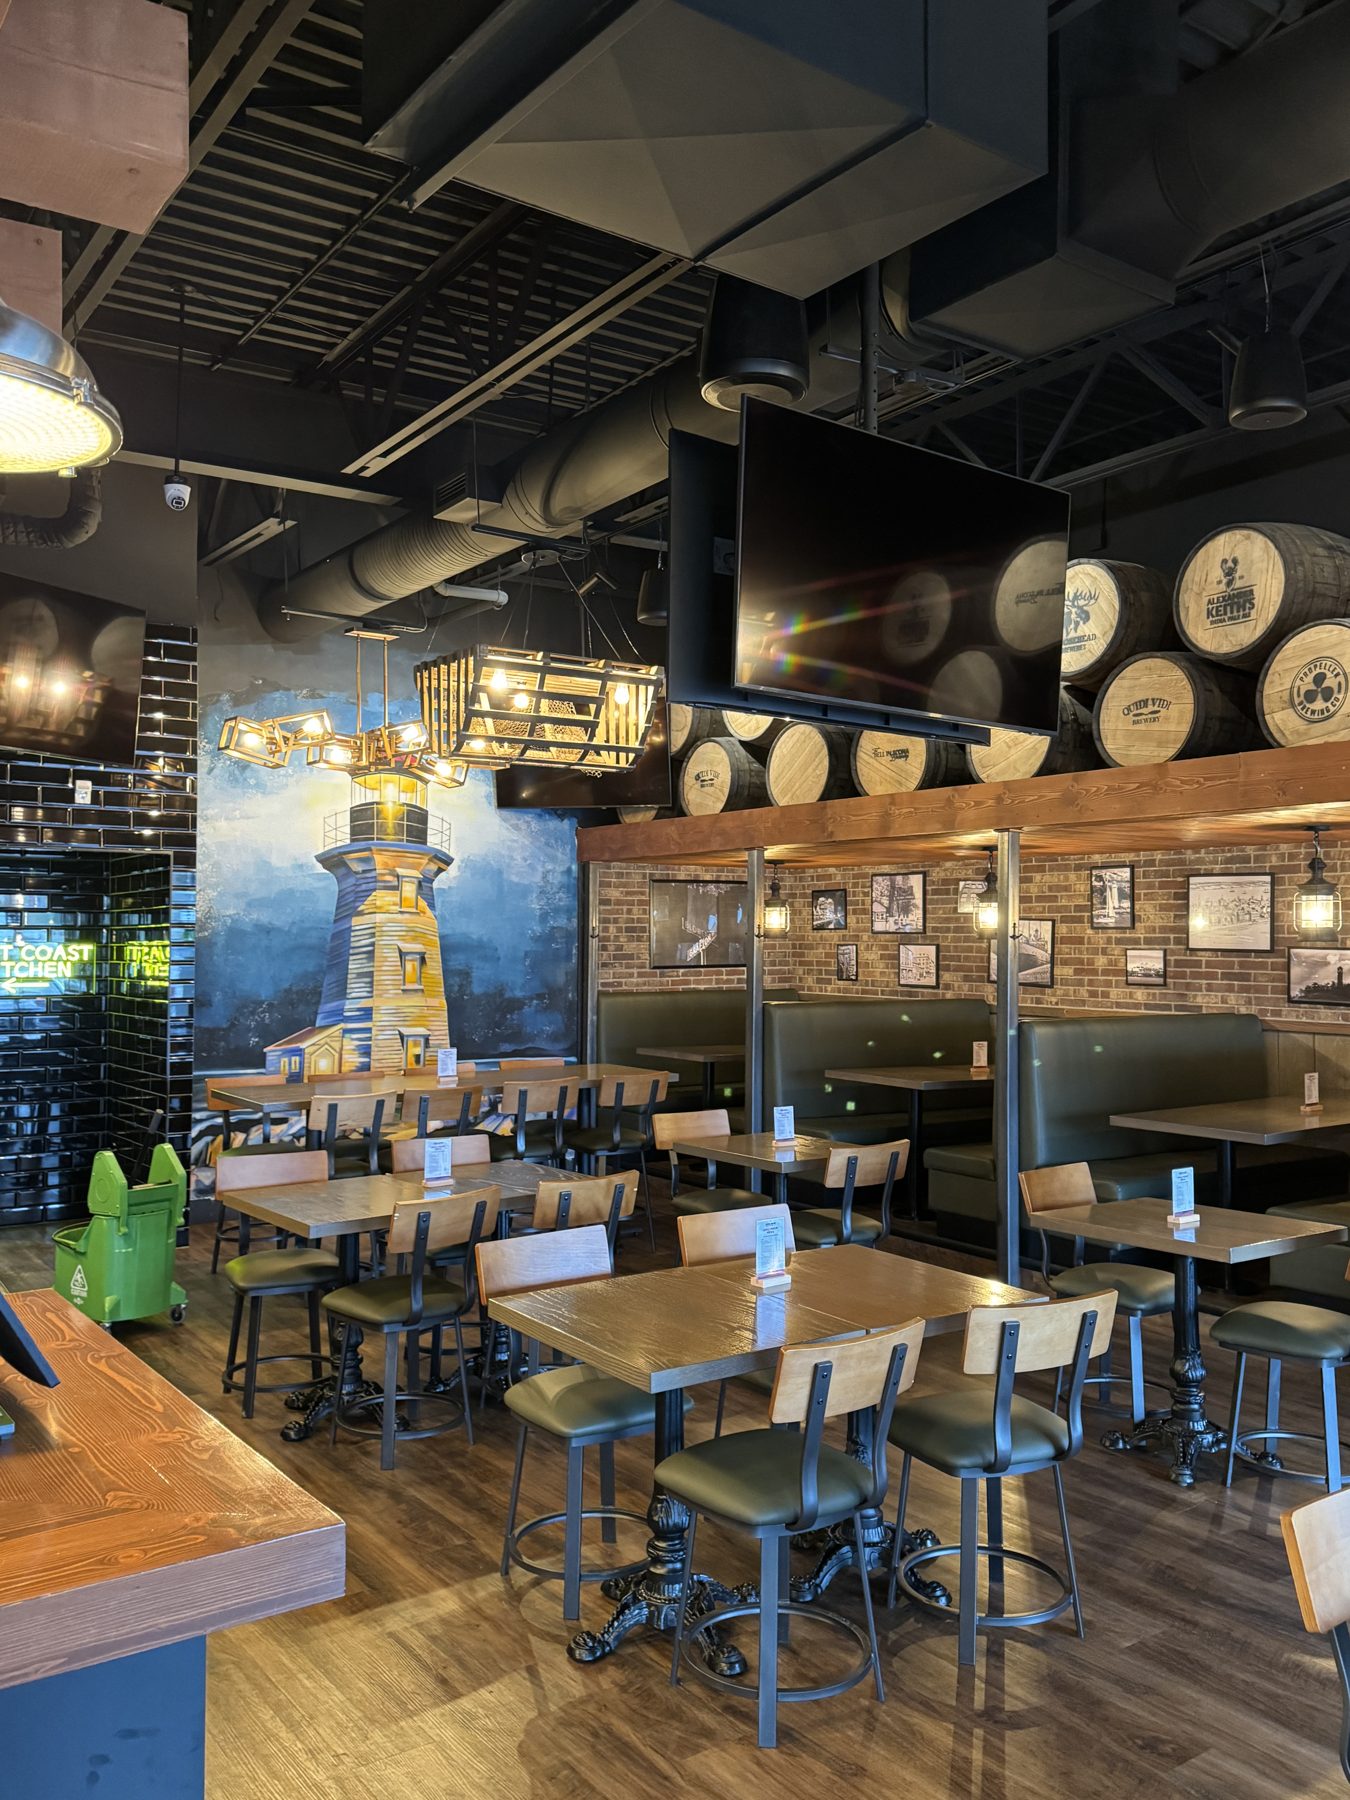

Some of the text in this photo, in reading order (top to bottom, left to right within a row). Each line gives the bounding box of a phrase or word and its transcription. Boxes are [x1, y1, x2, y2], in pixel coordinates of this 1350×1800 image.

[1206, 597, 1256, 619] KEITH'S
[1299, 662, 1341, 683] PROPELLER
[1122, 698, 1172, 716] QUIDI VIDI
[1297, 700, 1331, 717] BREWING
[1132, 716, 1160, 725] BREWERY
[20, 944, 93, 961] COAST
